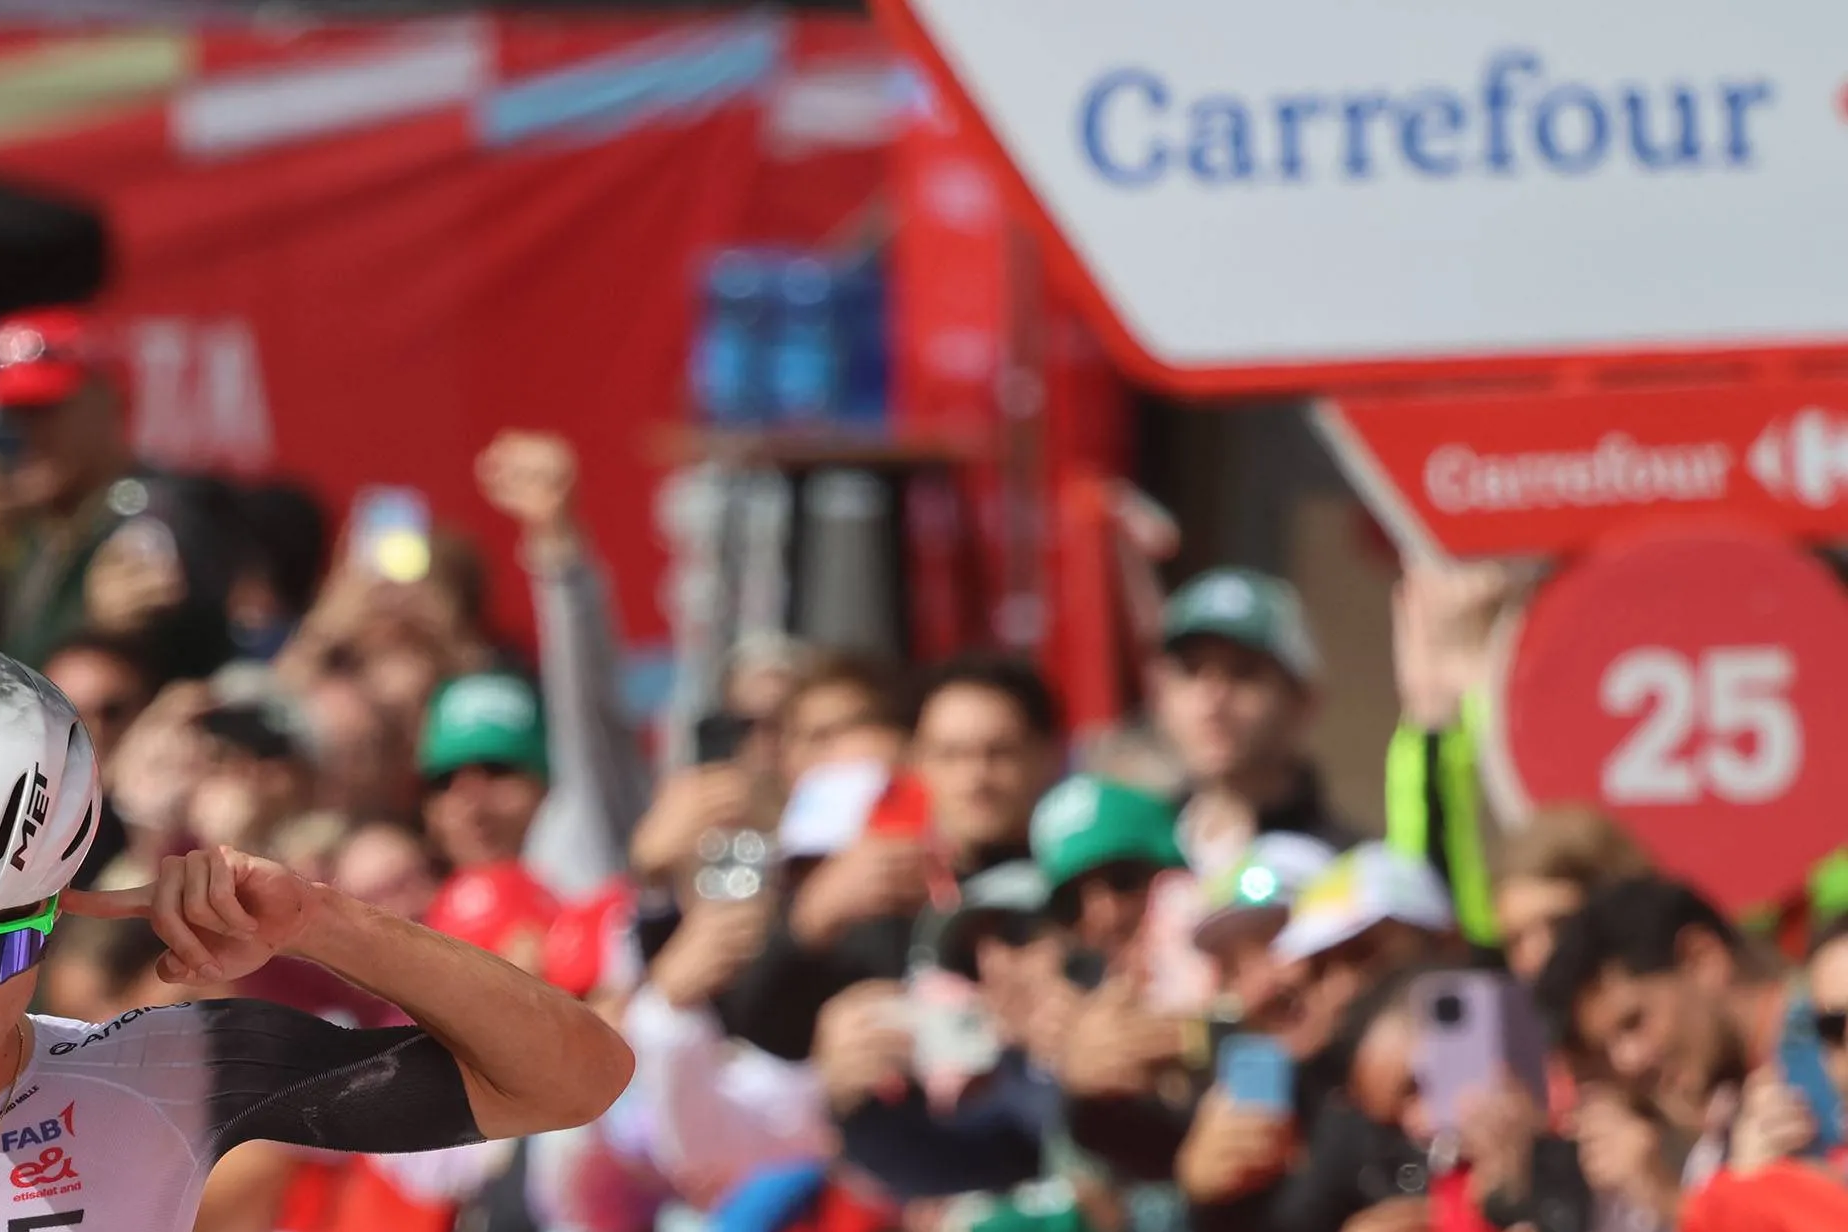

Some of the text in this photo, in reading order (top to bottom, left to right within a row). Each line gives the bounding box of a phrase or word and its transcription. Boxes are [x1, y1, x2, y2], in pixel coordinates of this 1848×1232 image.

[1077, 47, 1776, 190] Carrefour
[1424, 434, 1732, 515] Carrefour
[1599, 644, 1805, 806] 25
[9, 762, 48, 872] MET
[59, 1180, 82, 1194] and
